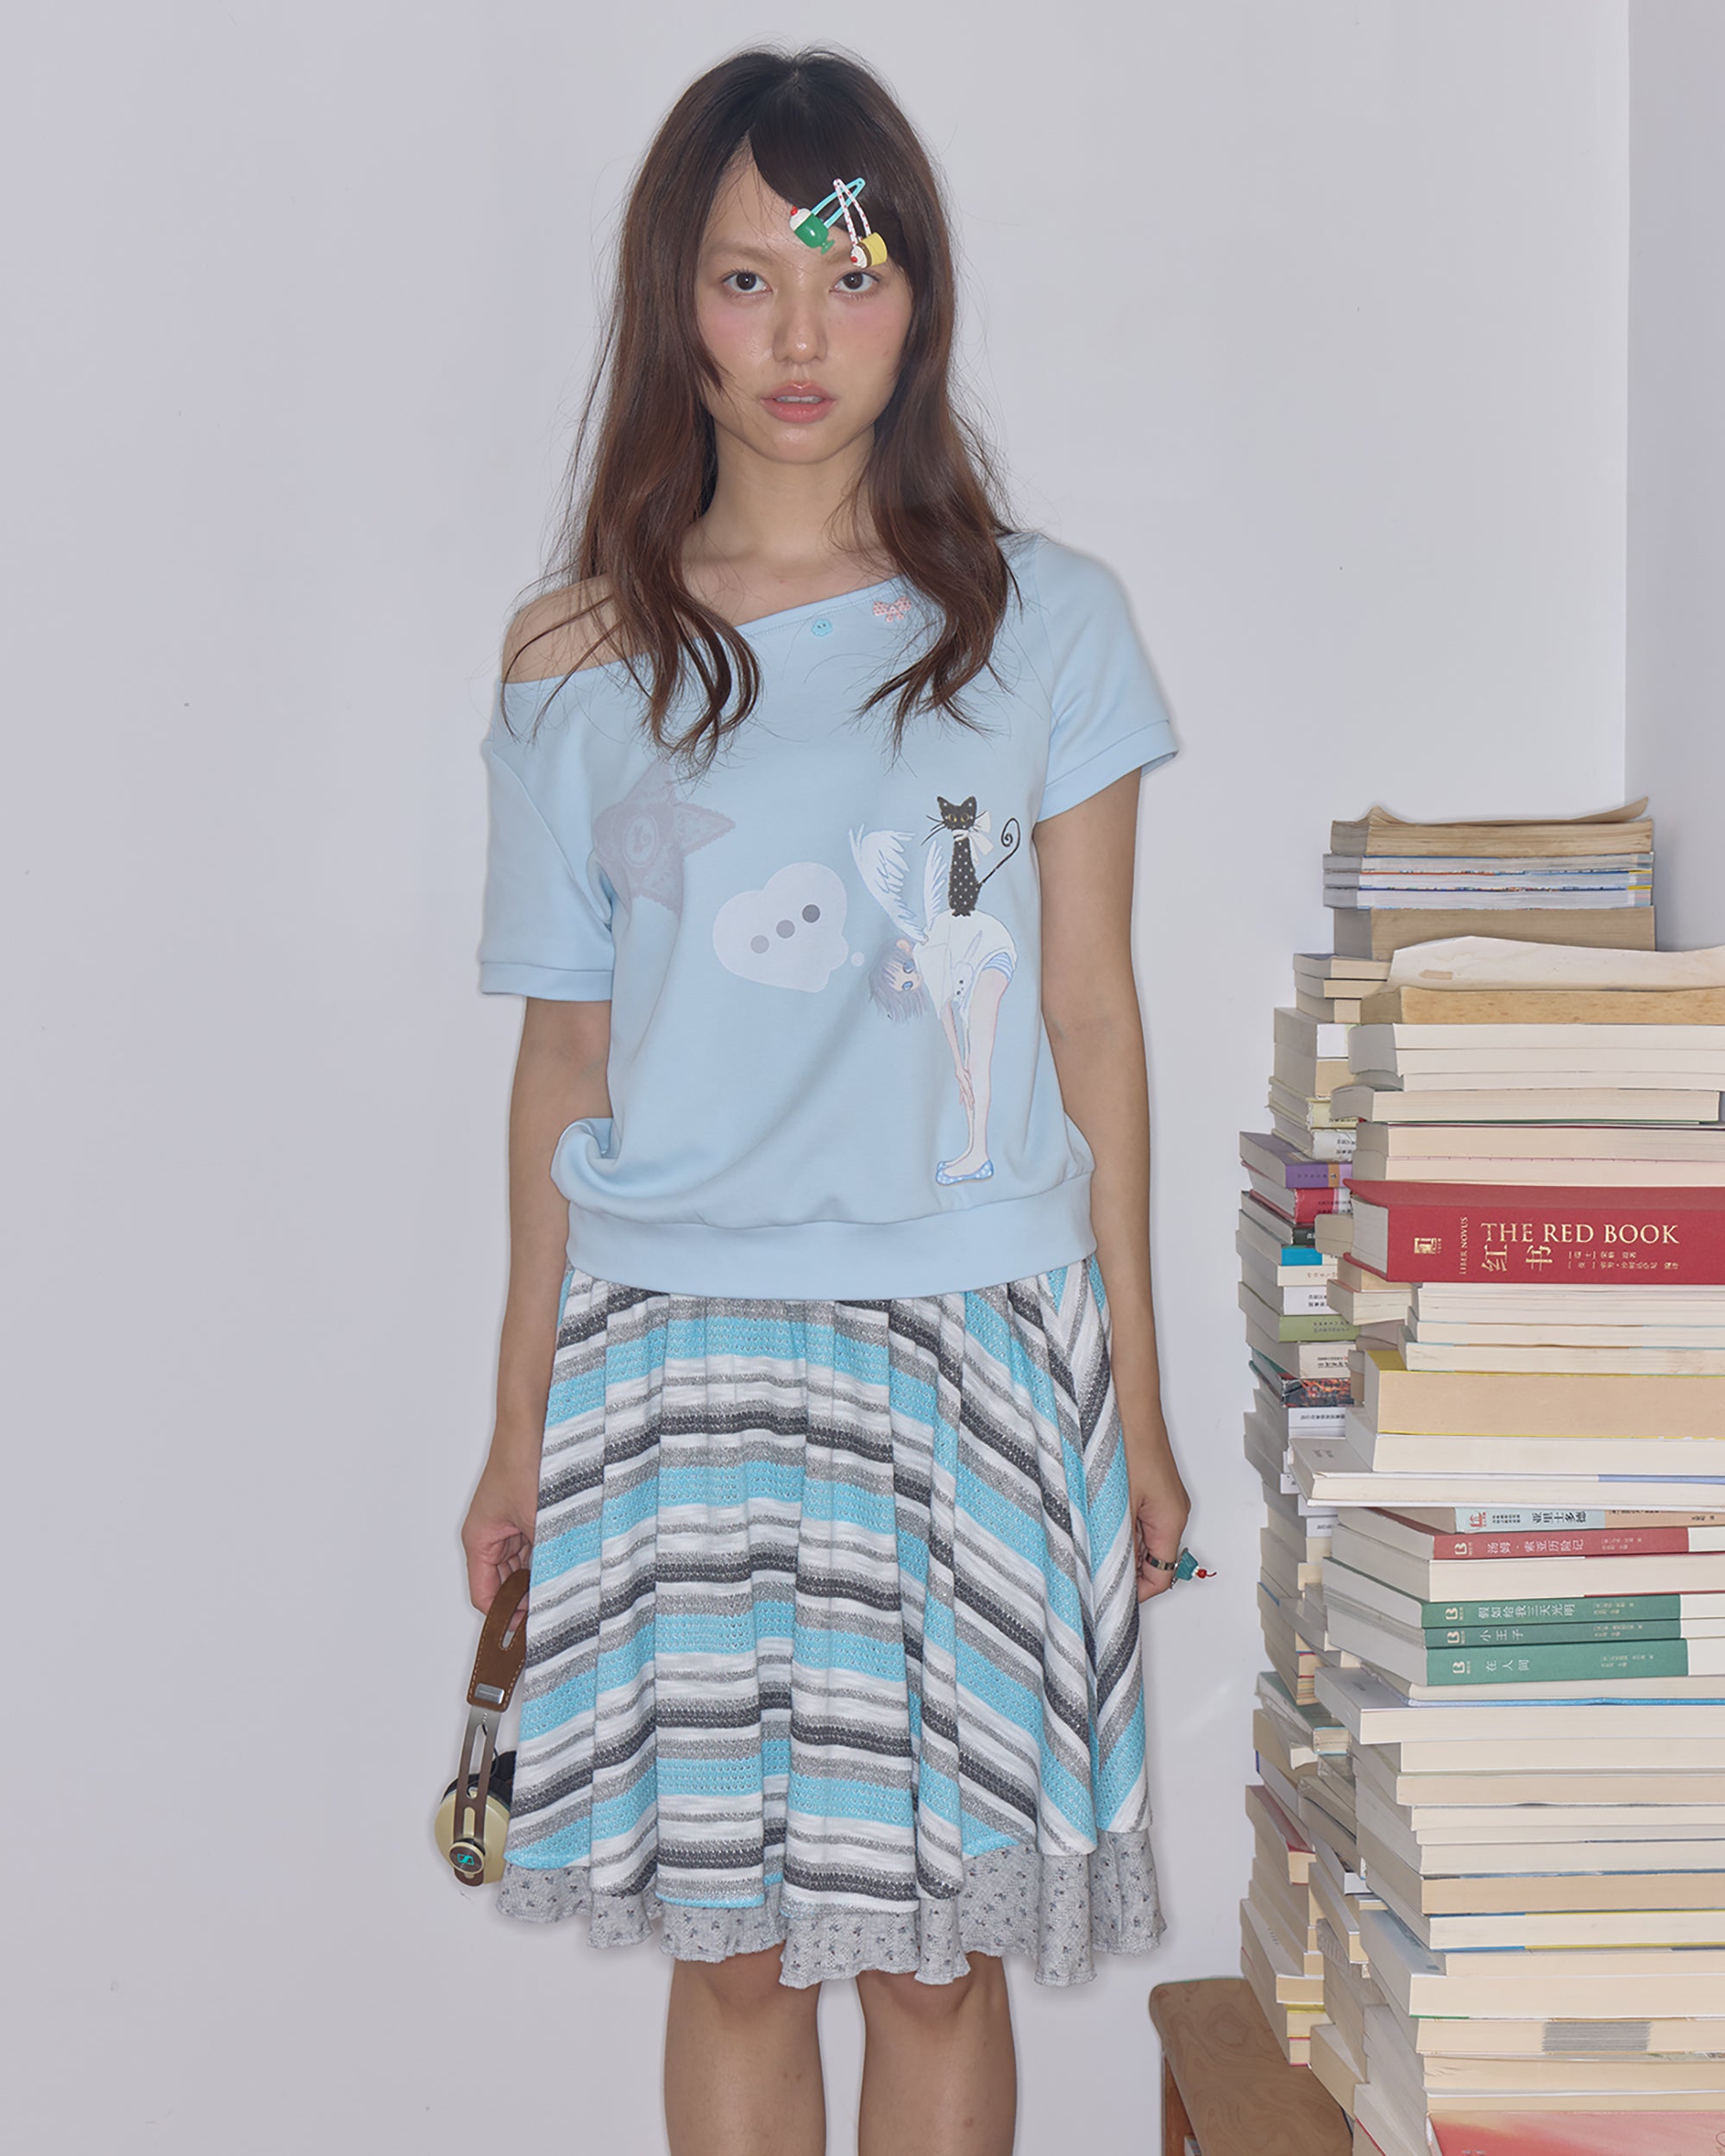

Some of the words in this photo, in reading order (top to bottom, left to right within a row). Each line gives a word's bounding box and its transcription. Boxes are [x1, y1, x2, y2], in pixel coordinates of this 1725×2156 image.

[1460, 1216, 1469, 1248] NOVUS
[1481, 1223, 1534, 1244] THE
[1543, 1224, 1595, 1244] RED
[1603, 1224, 1680, 1244] BOOK
[1459, 1250, 1468, 1275] LIBER
[1532, 1511, 1586, 1524] 亚里士多德
[1477, 1604, 1575, 1619] 假如给我三天光明
[1479, 1628, 1524, 1642] 小王子
[1485, 1658, 1530, 1672] 在人间
